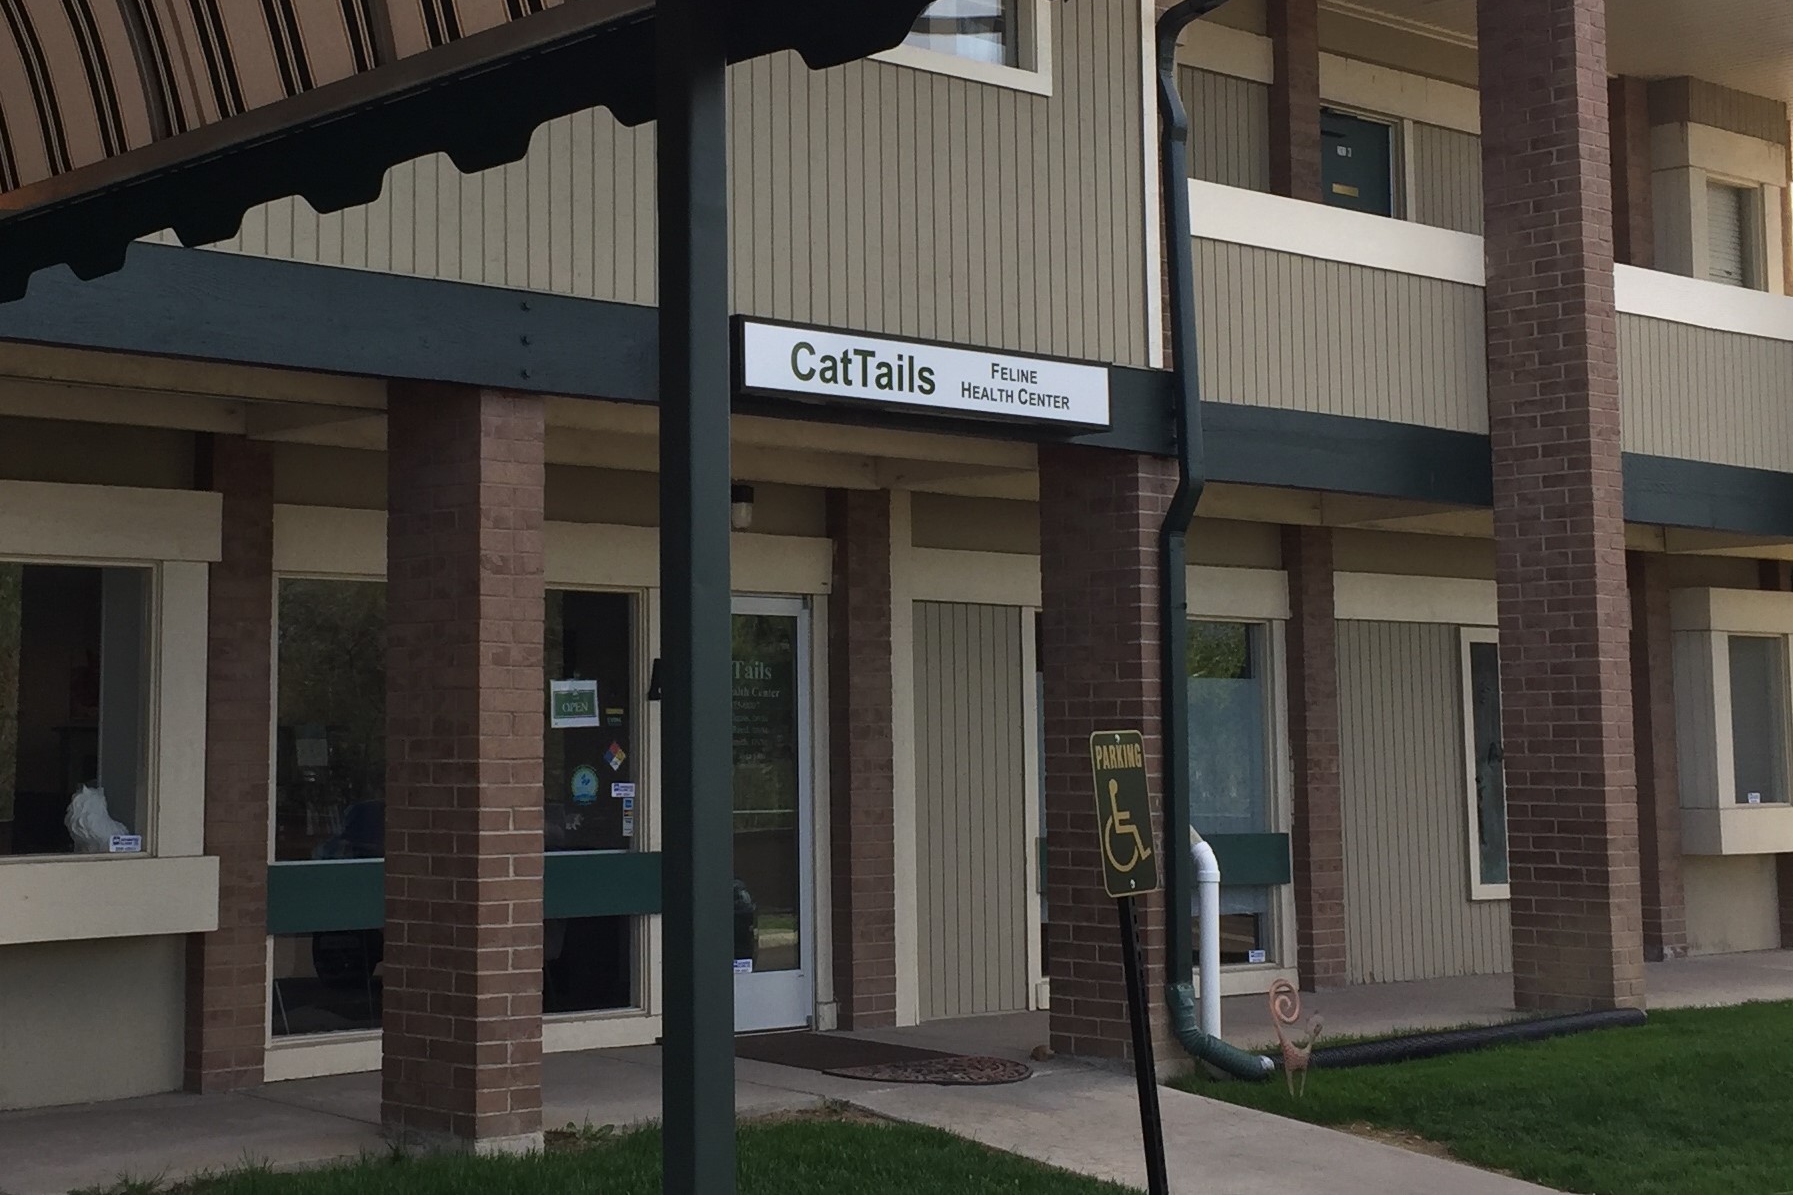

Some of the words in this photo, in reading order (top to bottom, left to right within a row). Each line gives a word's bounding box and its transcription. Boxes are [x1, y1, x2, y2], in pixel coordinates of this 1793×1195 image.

[790, 341, 937, 396] CatTails
[991, 362, 1038, 385] FELINE
[961, 381, 1014, 404] HEALTH
[1017, 388, 1070, 410] CENTER
[732, 660, 773, 680] Tails
[562, 701, 589, 713] OPEN
[1094, 743, 1143, 771] PARKING
